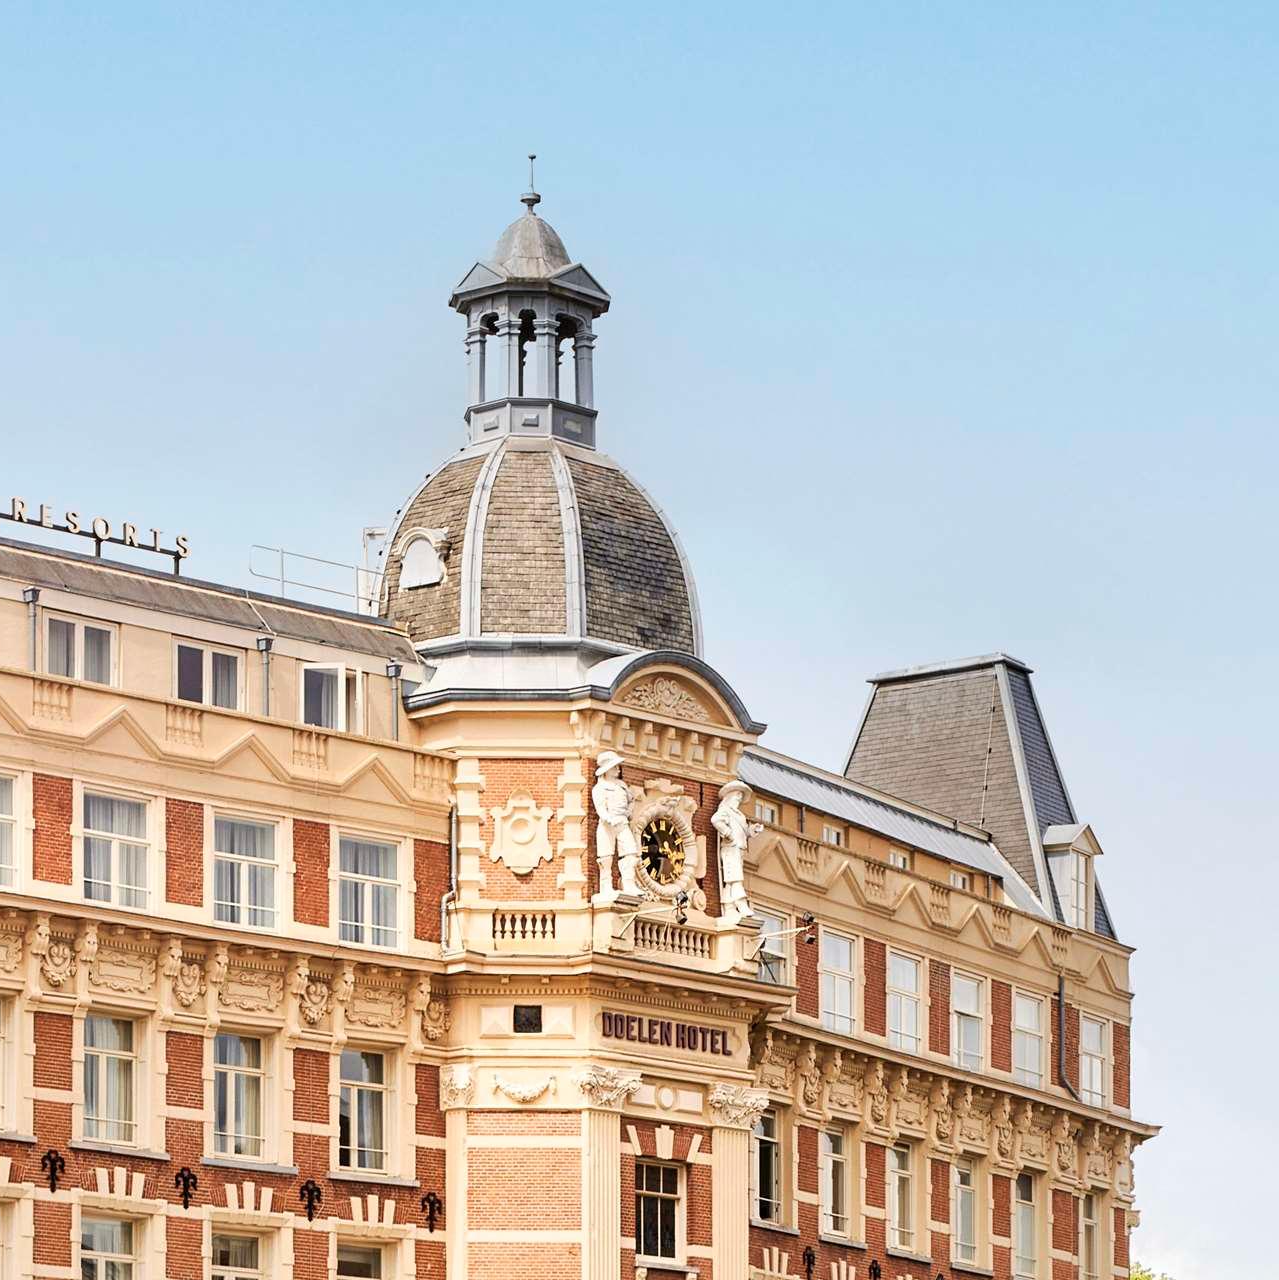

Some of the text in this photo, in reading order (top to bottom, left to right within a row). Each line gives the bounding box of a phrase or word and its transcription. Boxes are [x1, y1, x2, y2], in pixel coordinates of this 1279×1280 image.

[11, 497, 192, 558] RESORTS
[602, 1011, 732, 1056] DOELEN HOTEL
